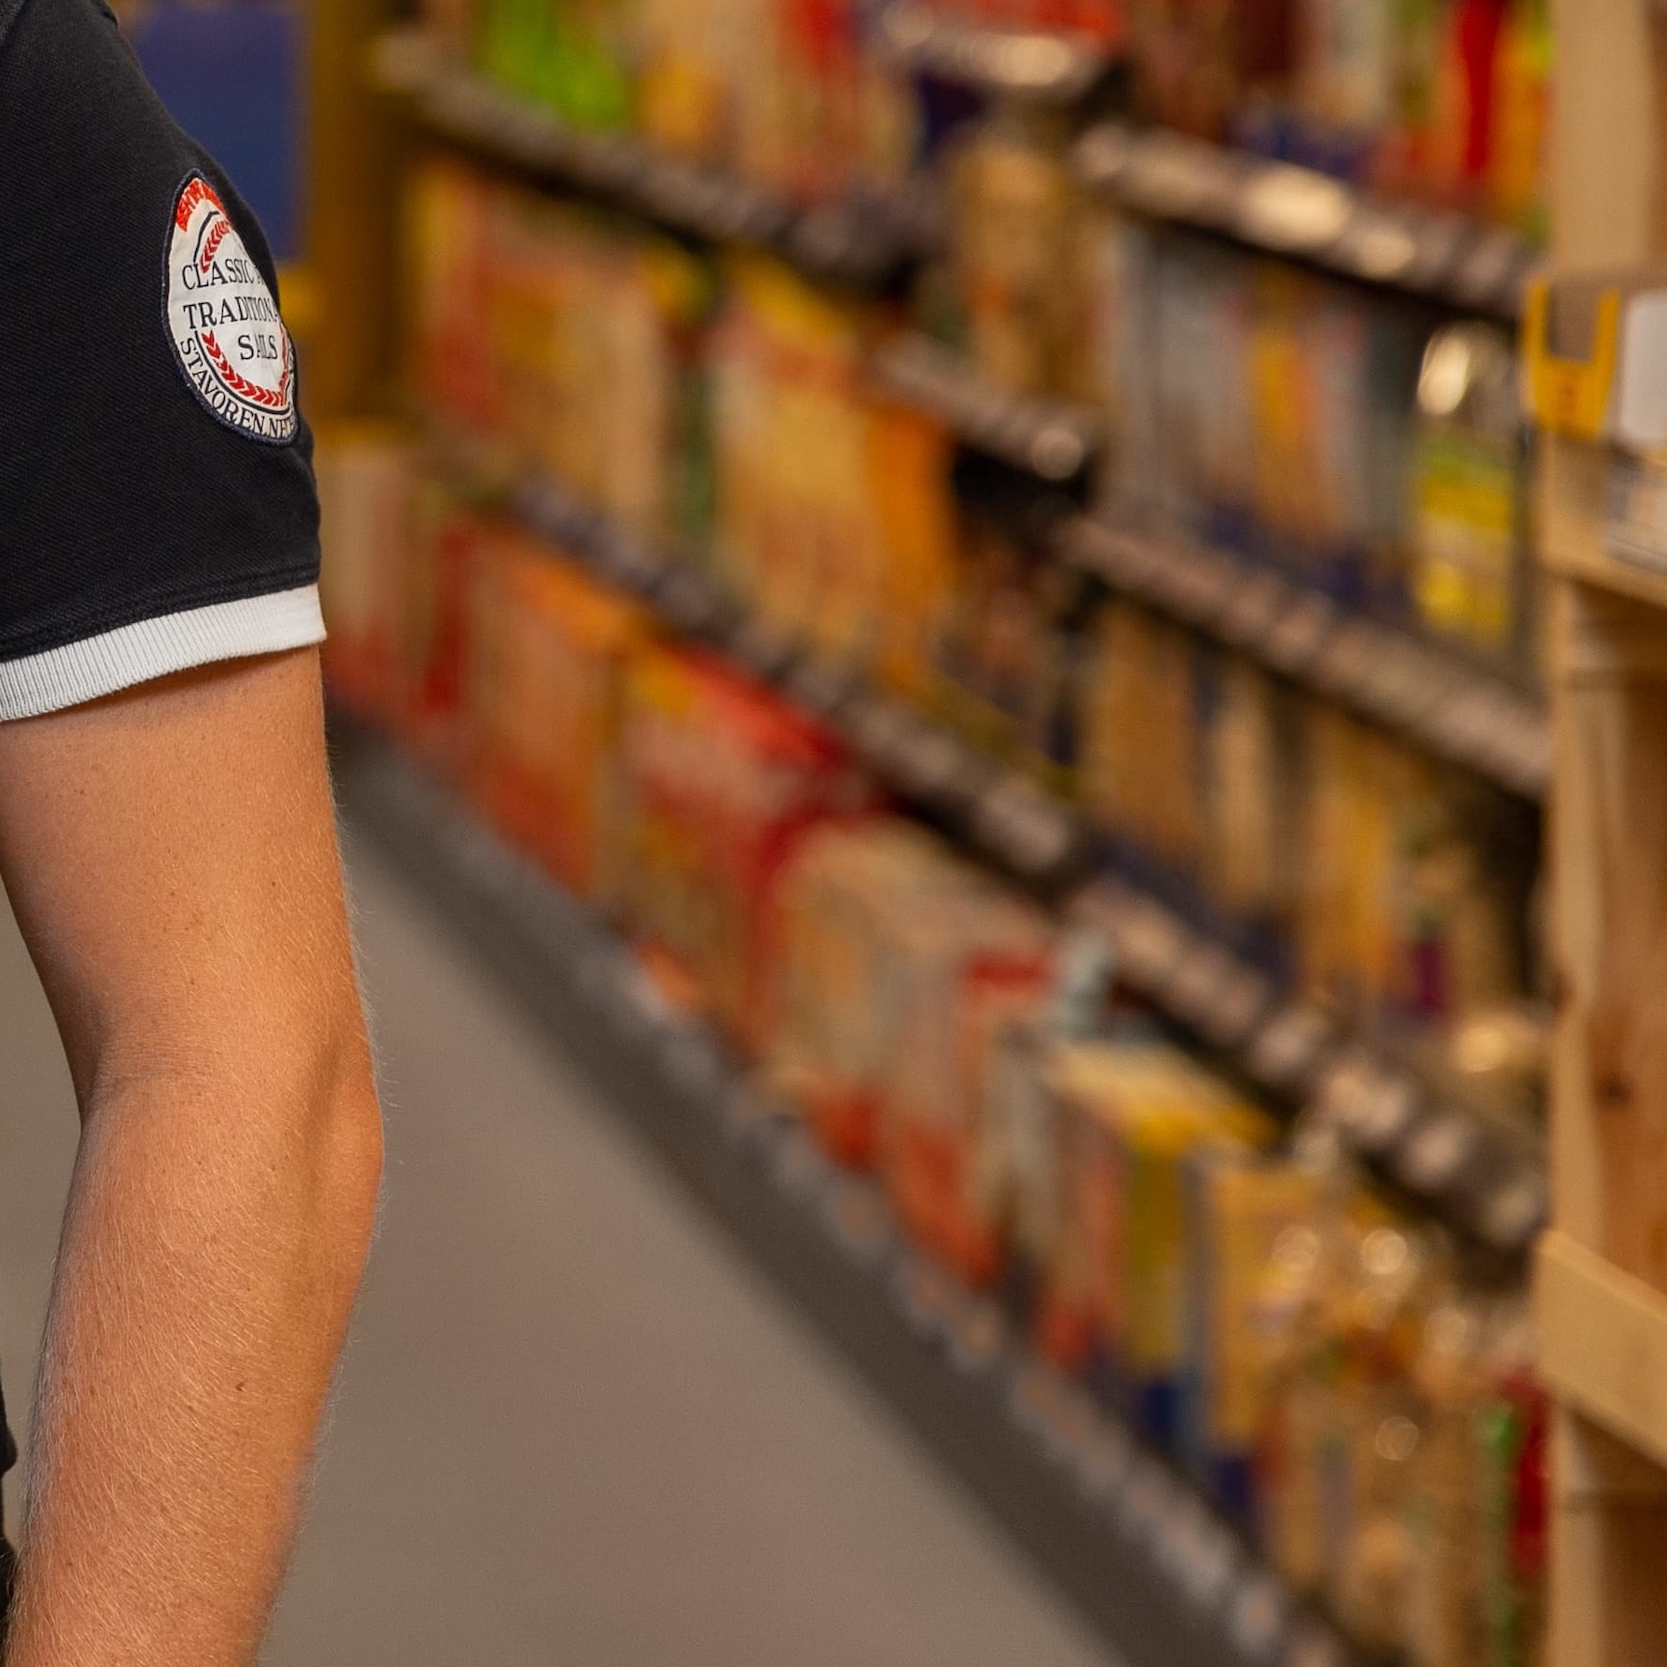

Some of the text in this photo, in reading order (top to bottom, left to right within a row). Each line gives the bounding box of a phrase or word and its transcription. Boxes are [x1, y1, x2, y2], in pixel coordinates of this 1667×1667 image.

[182, 257, 255, 291] CLASSIC
[237, 333, 278, 361] SAILS
[180, 338, 265, 436] STAVOREN
